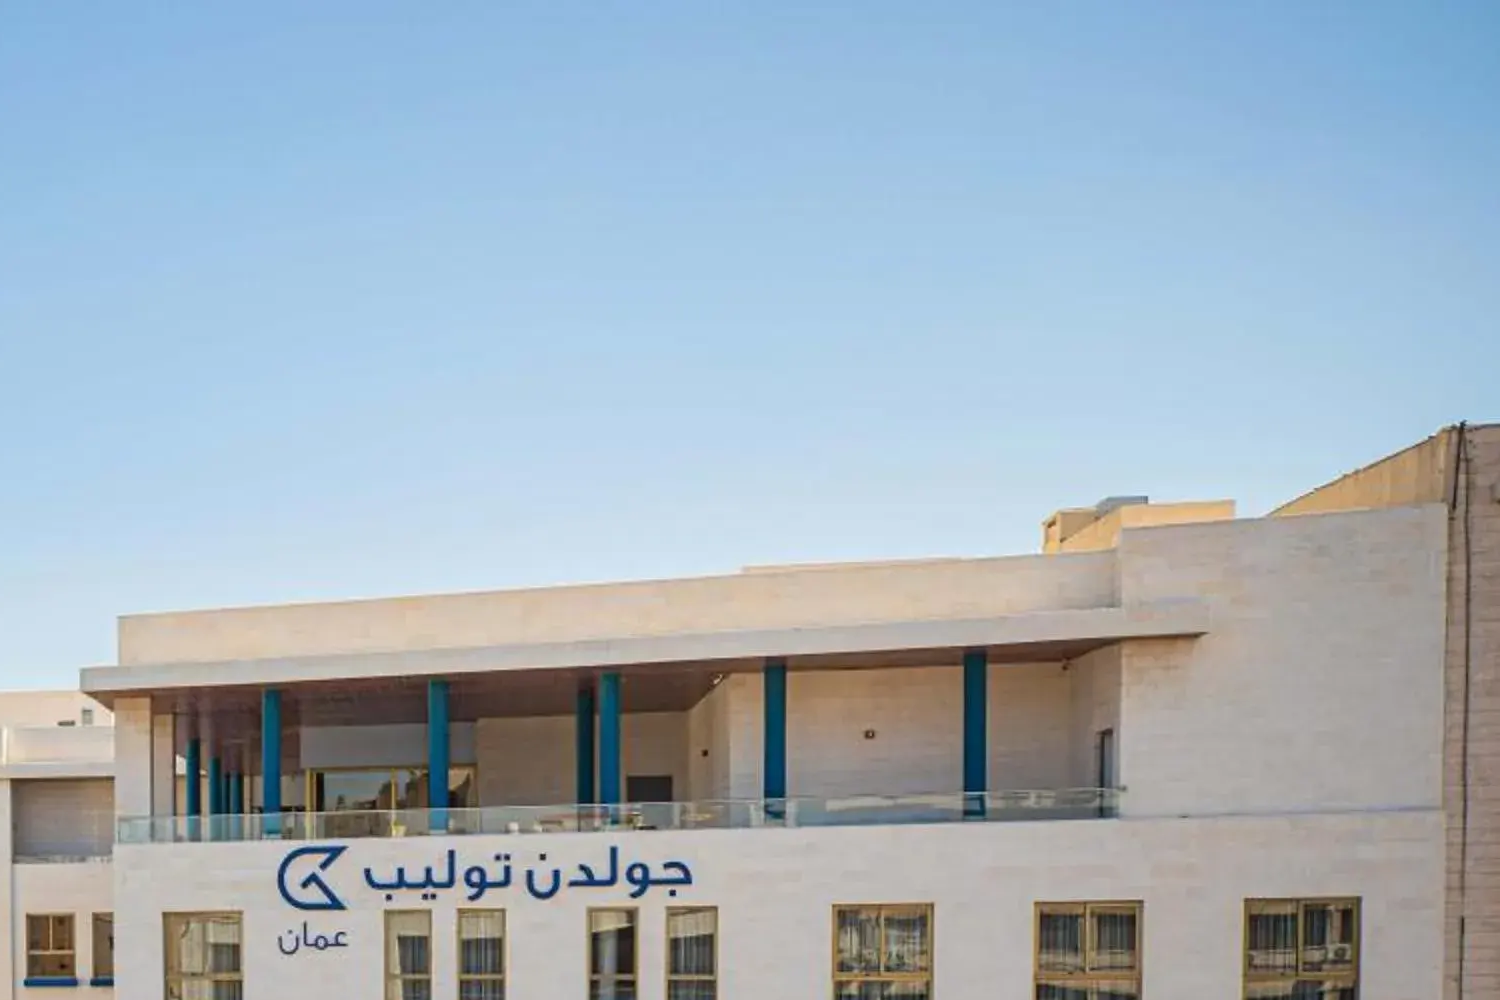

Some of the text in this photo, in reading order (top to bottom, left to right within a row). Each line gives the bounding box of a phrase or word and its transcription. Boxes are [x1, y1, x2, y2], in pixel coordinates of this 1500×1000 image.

[363, 845, 693, 901] جولدن توليب
[277, 920, 349, 955] عمان
